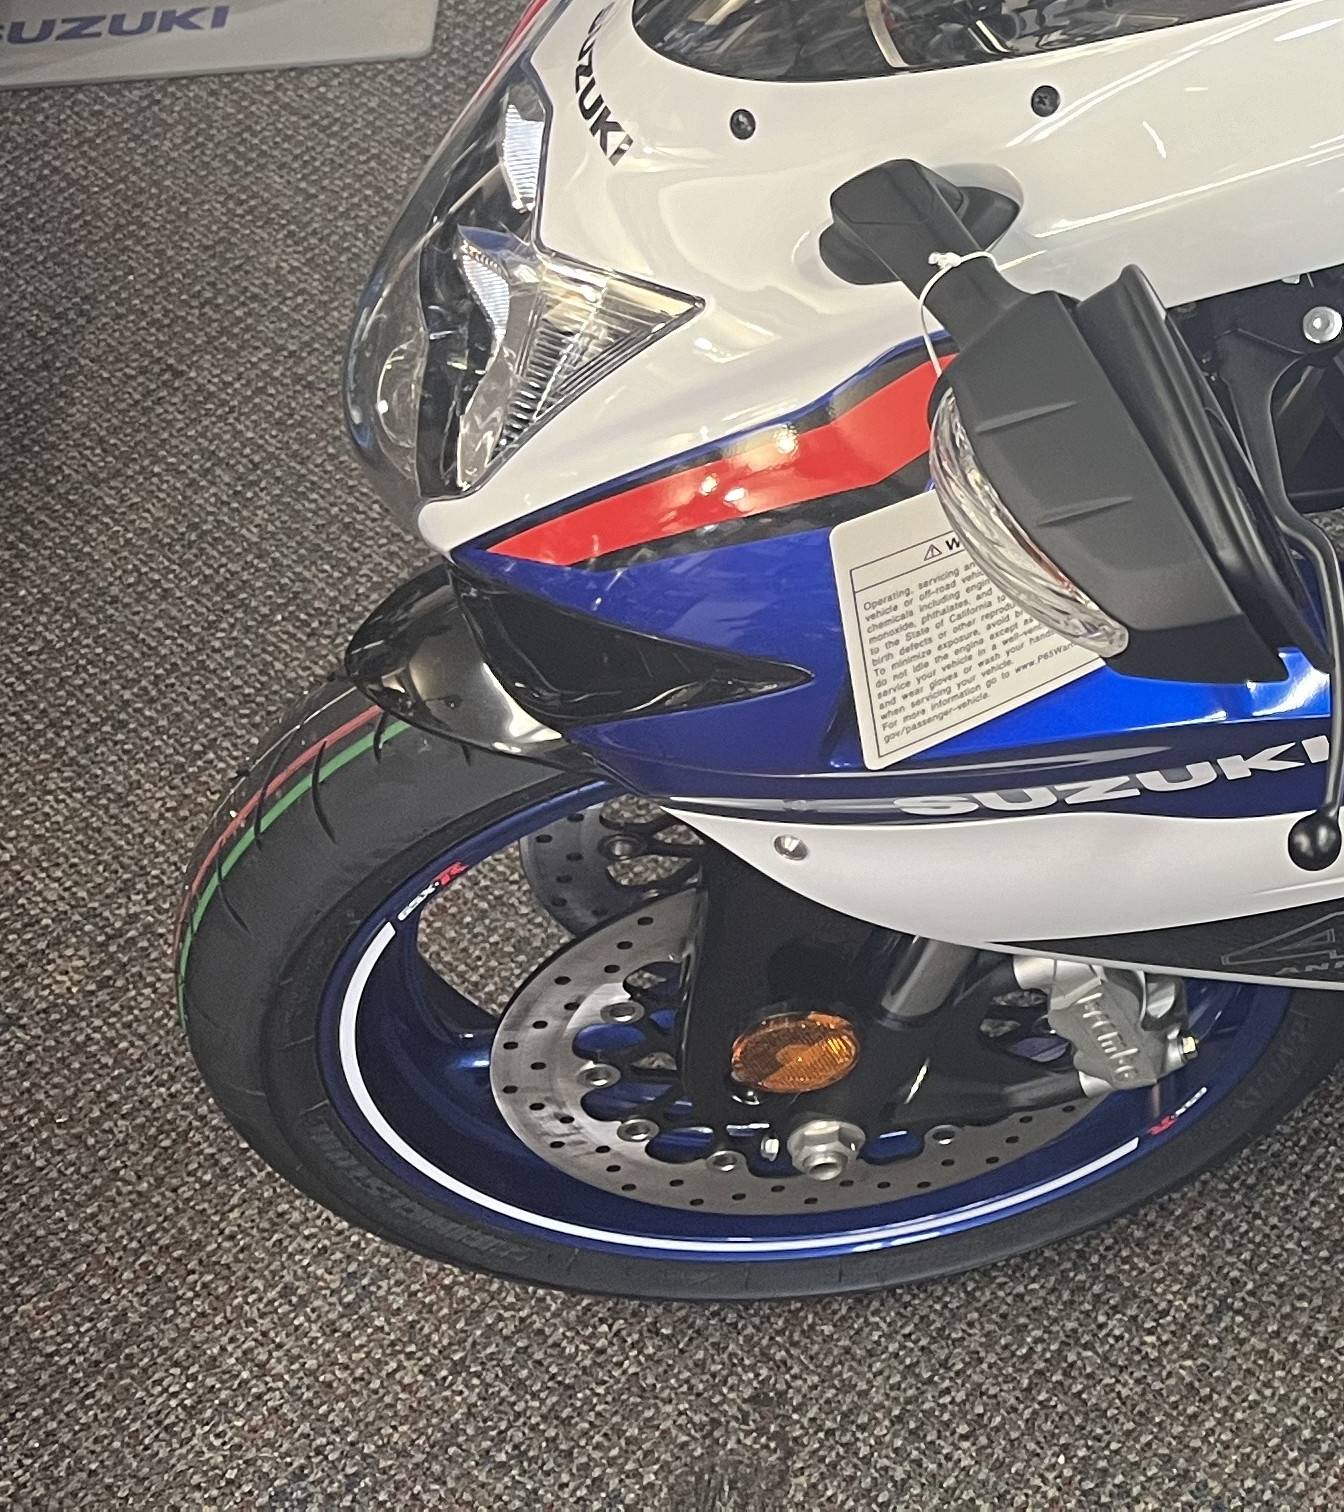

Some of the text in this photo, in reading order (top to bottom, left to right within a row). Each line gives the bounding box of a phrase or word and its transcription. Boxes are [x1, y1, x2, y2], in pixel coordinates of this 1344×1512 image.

[0, 5, 230, 44] UZUKI
[574, 1, 634, 166] SUZUKI
[865, 604, 898, 622] vehicle
[903, 598, 913, 607] or
[919, 580, 957, 601] off-road
[965, 578, 990, 594] engin
[976, 588, 993, 601] and
[870, 647, 880, 655] to
[885, 639, 900, 649] the
[905, 627, 930, 642] State
[935, 619, 944, 629] of
[997, 594, 1006, 603] to
[872, 652, 894, 666] birth
[899, 637, 933, 655] defects
[937, 631, 947, 640] or
[952, 619, 976, 633] other
[874, 668, 886, 677] To
[891, 649, 932, 670] minimize
[986, 614, 1010, 630] avoid
[876, 679, 888, 688] do
[893, 669, 908, 681] not
[913, 661, 929, 673] idle
[934, 653, 949, 664] the
[954, 638, 984, 656] engine
[990, 622, 1019, 641] except
[877, 681, 911, 699] service
[916, 669, 936, 685] your
[941, 654, 973, 672] vehicle
[978, 648, 986, 657] in
[880, 696, 897, 710] and
[901, 687, 923, 700] wear
[929, 671, 958, 691] gloves
[963, 665, 973, 674] or
[977, 653, 1001, 668] wash
[1005, 642, 1025, 657] your
[880, 706, 905, 720] when
[957, 675, 976, 690] your
[882, 720, 898, 731] For
[903, 709, 926, 723] more
[985, 677, 997, 689] go
[1001, 671, 1010, 680] to
[893, 734, 1329, 816] SUZUKI
